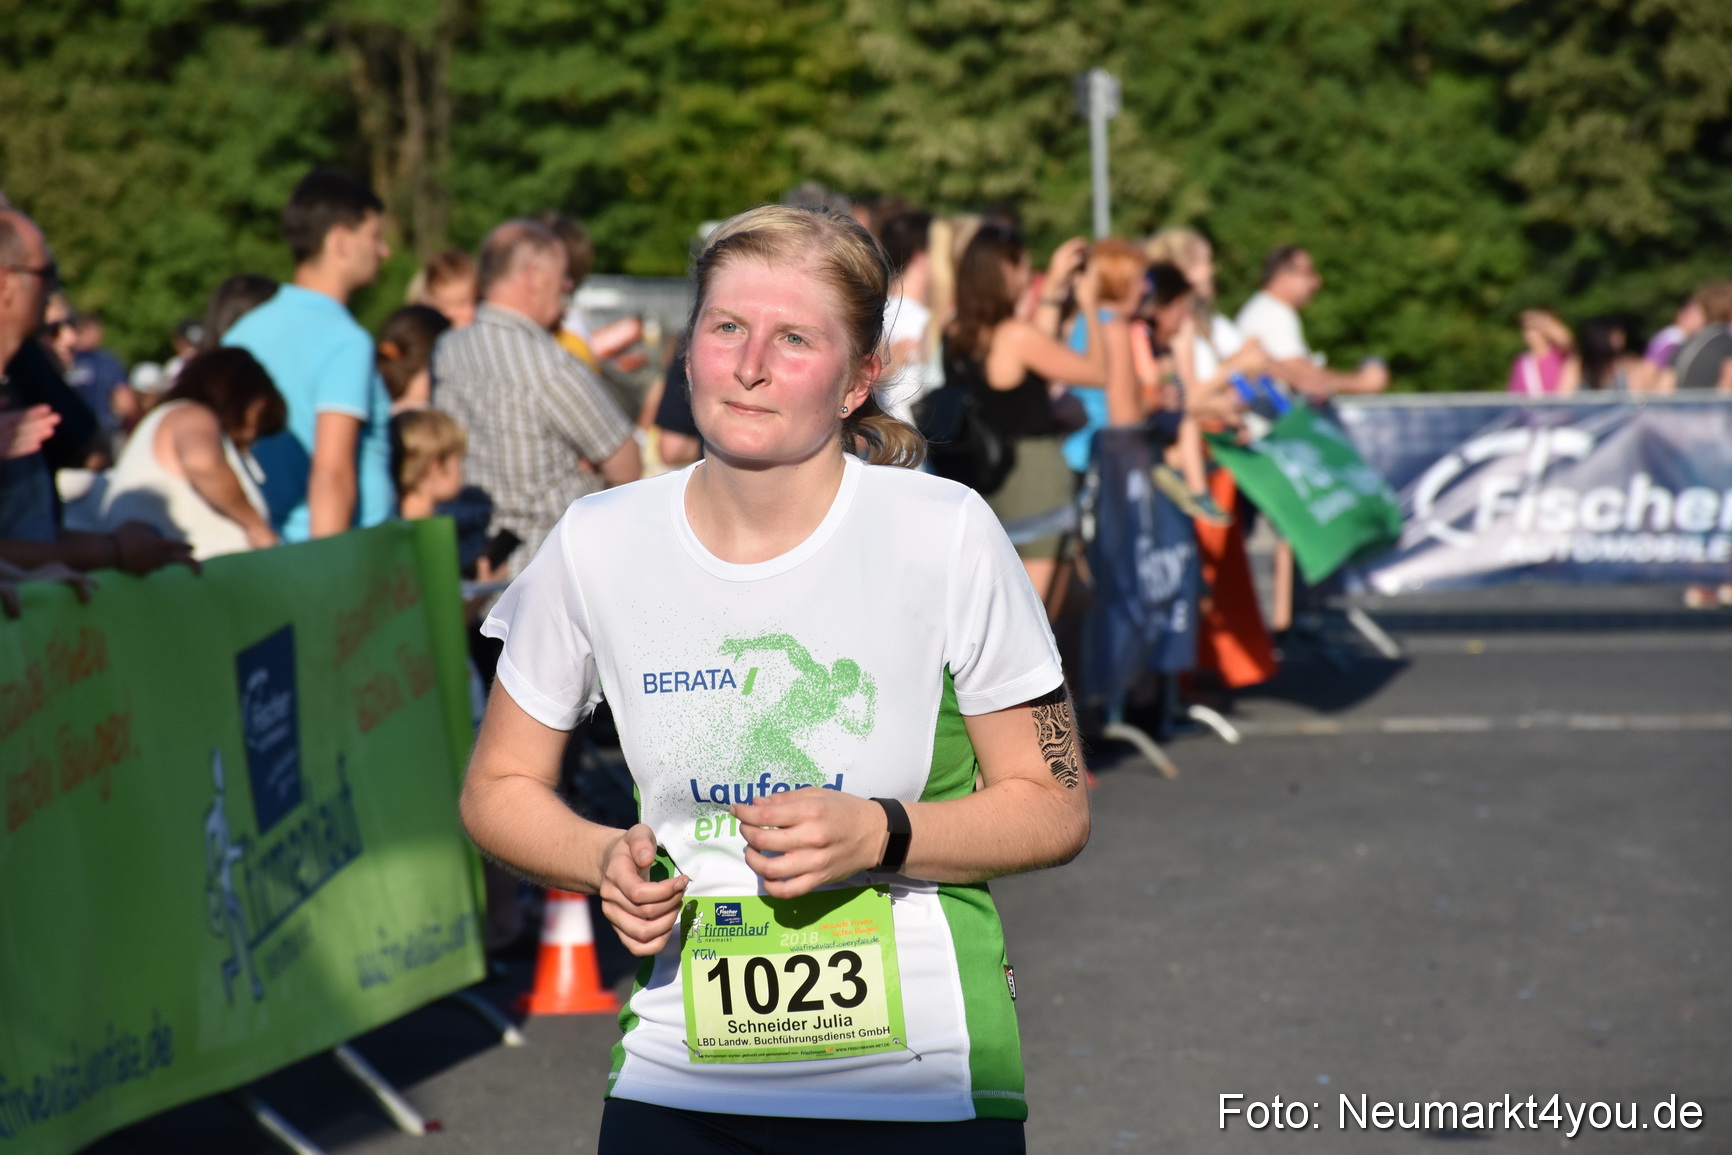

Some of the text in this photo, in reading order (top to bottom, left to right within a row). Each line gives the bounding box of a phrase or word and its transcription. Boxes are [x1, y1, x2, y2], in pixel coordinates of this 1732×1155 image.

[642, 668, 737, 694] BERATA
[704, 922, 770, 937] firmenlauf
[780, 931, 819, 946] 2018
[707, 950, 868, 1016] 1023
[727, 1013, 853, 1034] Schneider Julia
[697, 1026, 891, 1047] LBD Landw. Buchführungsdienst GmbH
